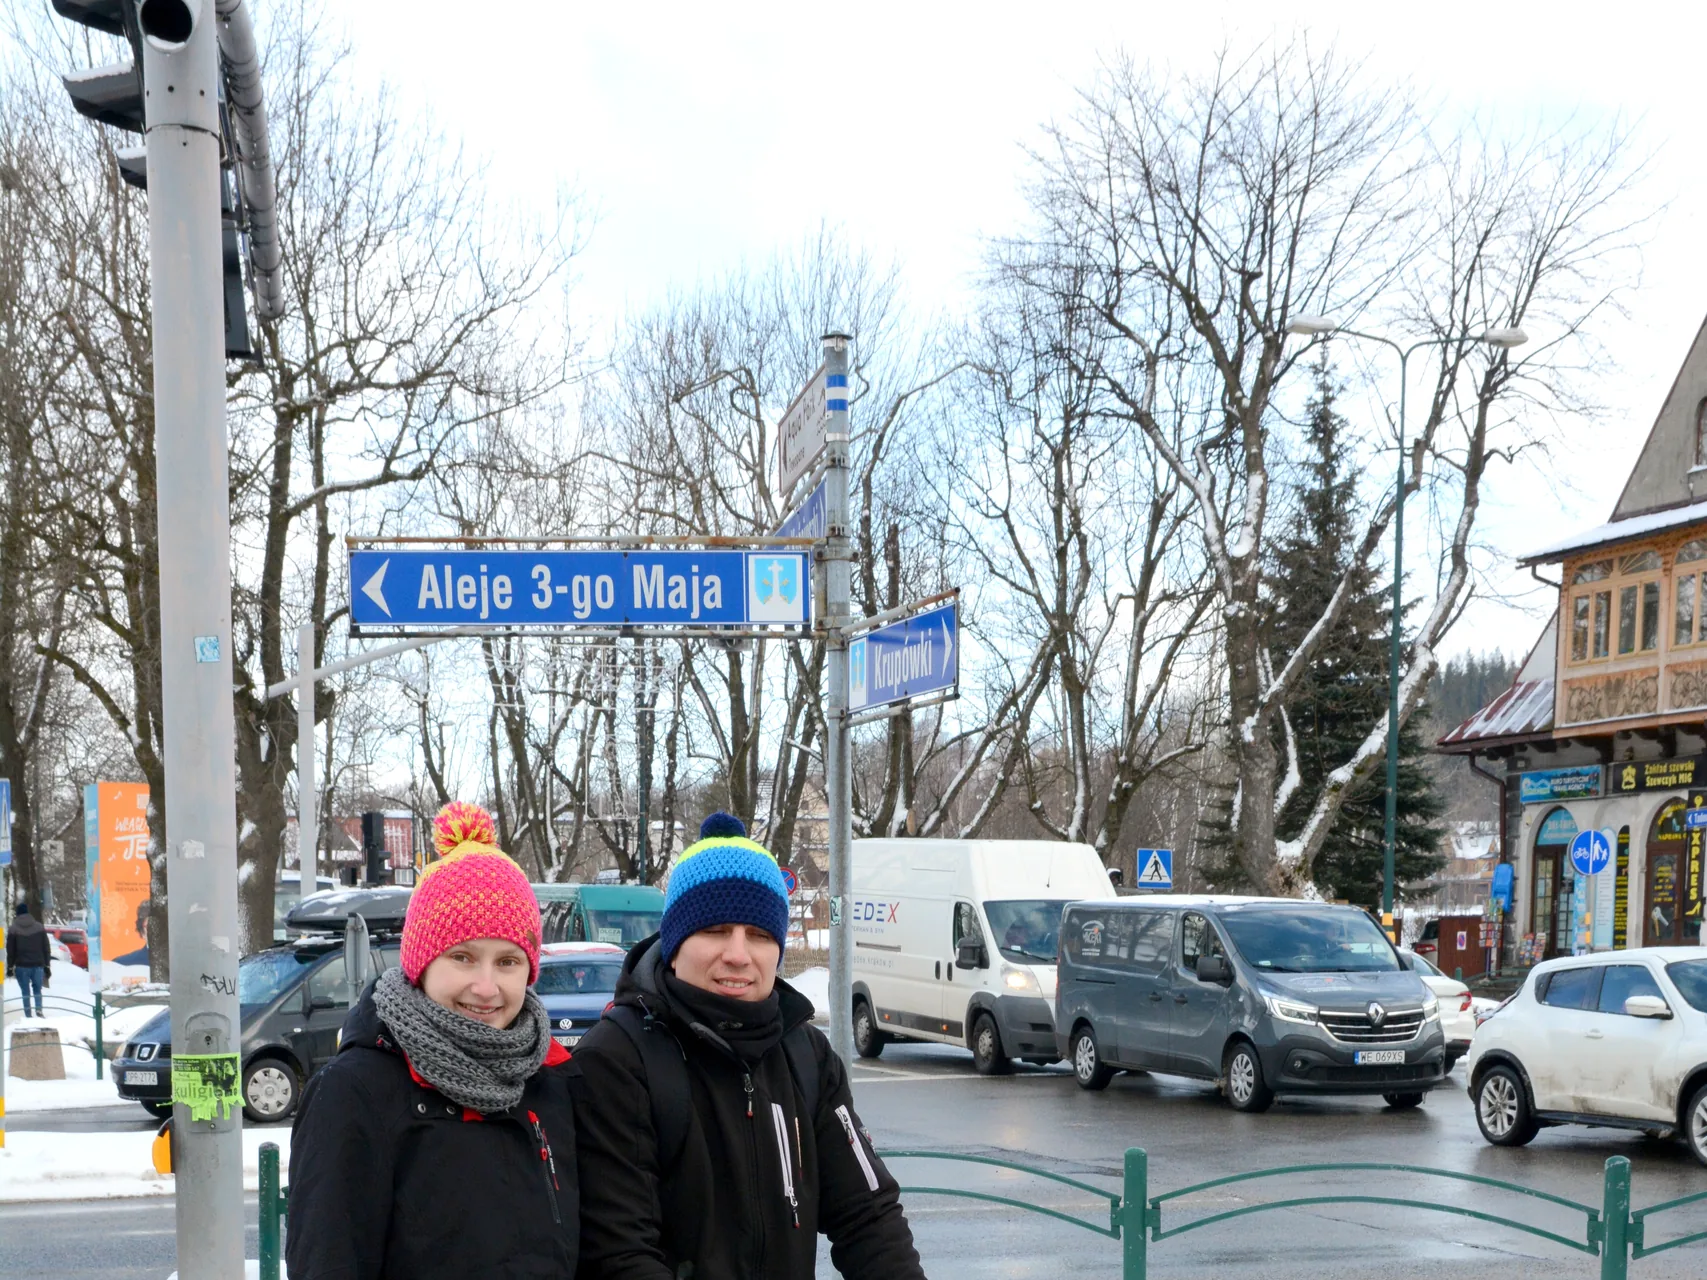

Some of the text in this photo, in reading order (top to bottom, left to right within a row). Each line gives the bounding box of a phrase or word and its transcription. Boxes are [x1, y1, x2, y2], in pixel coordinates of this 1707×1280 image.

[417, 564, 723, 619] Aleje 3-go Maja
[874, 627, 932, 697] Krupówki
[1645, 760, 1695, 775] Zakład szewski
[1646, 774, 1677, 787] Szewczyk
[1690, 826, 1701, 900] XPRES
[1361, 1051, 1403, 1062] WE 069XS
